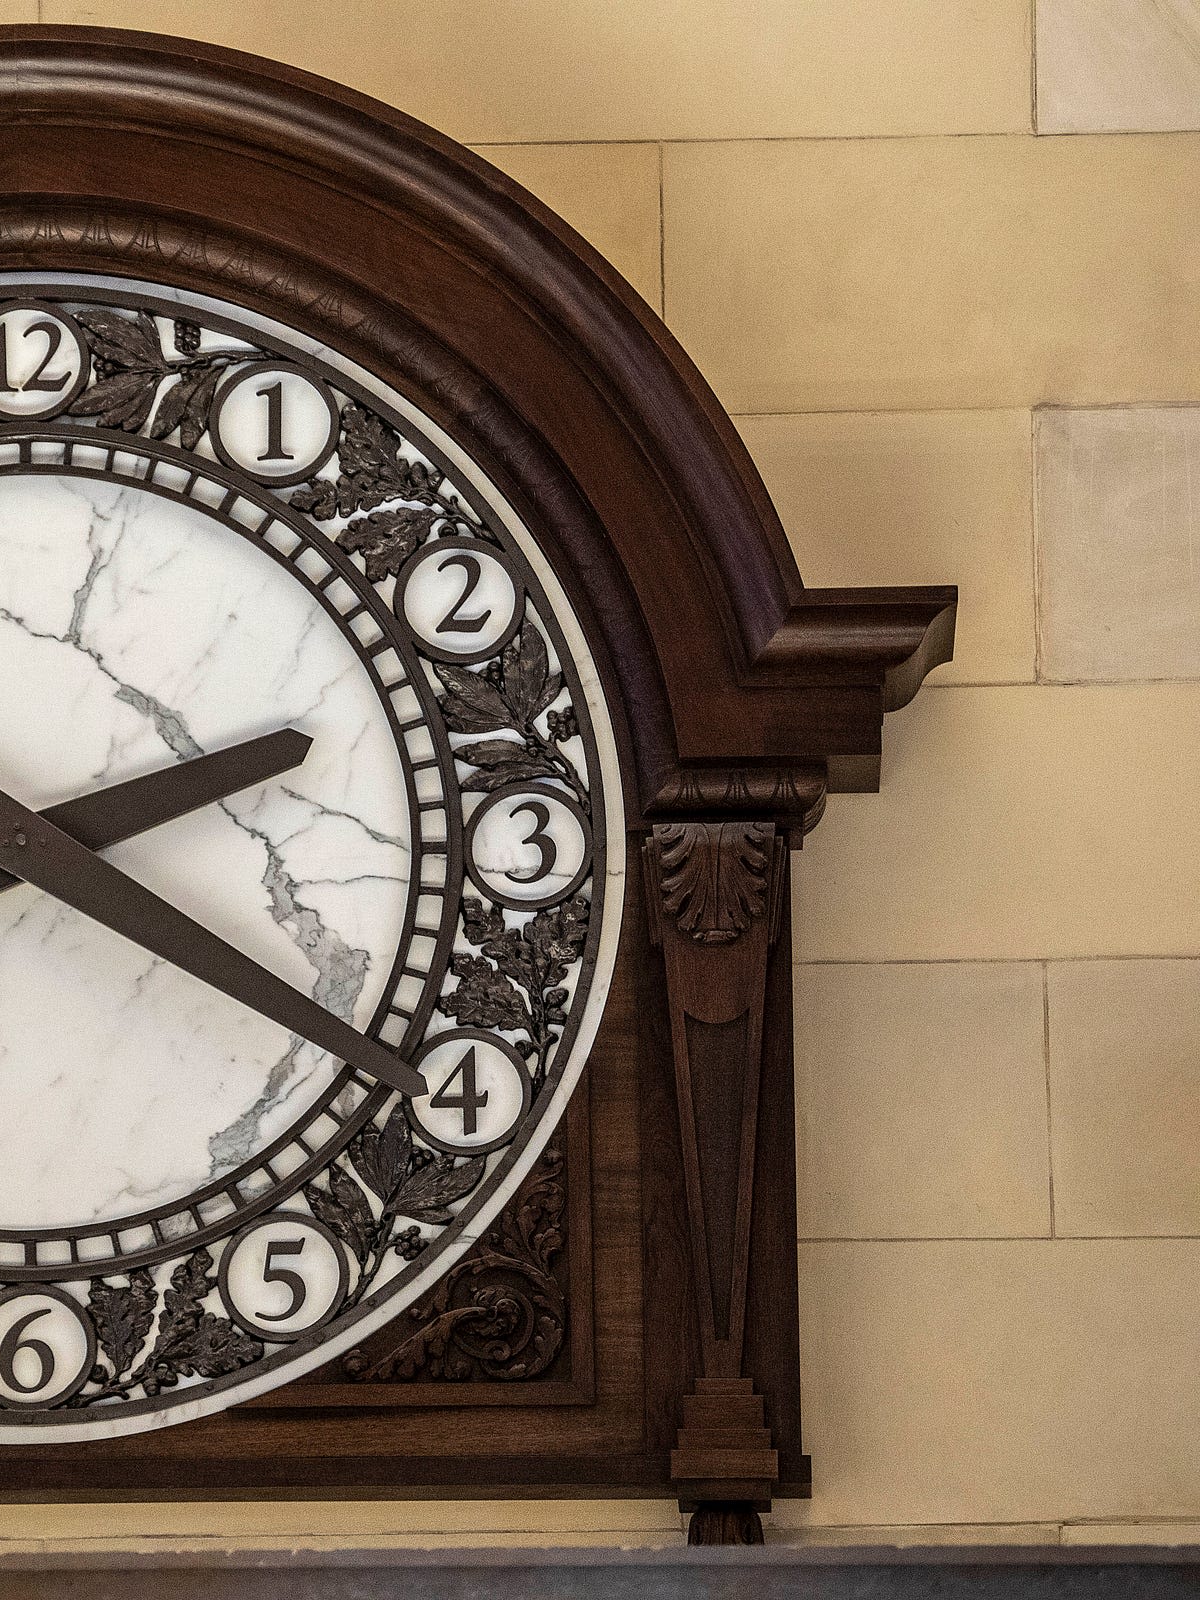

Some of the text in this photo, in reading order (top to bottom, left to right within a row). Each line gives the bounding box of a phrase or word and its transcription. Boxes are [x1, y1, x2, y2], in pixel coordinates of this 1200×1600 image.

[256, 382, 294, 461] 1
[436, 554, 491, 633] 2
[504, 802, 557, 884] 3
[430, 1046, 488, 1136] 4
[255, 1237, 306, 1321] 5
